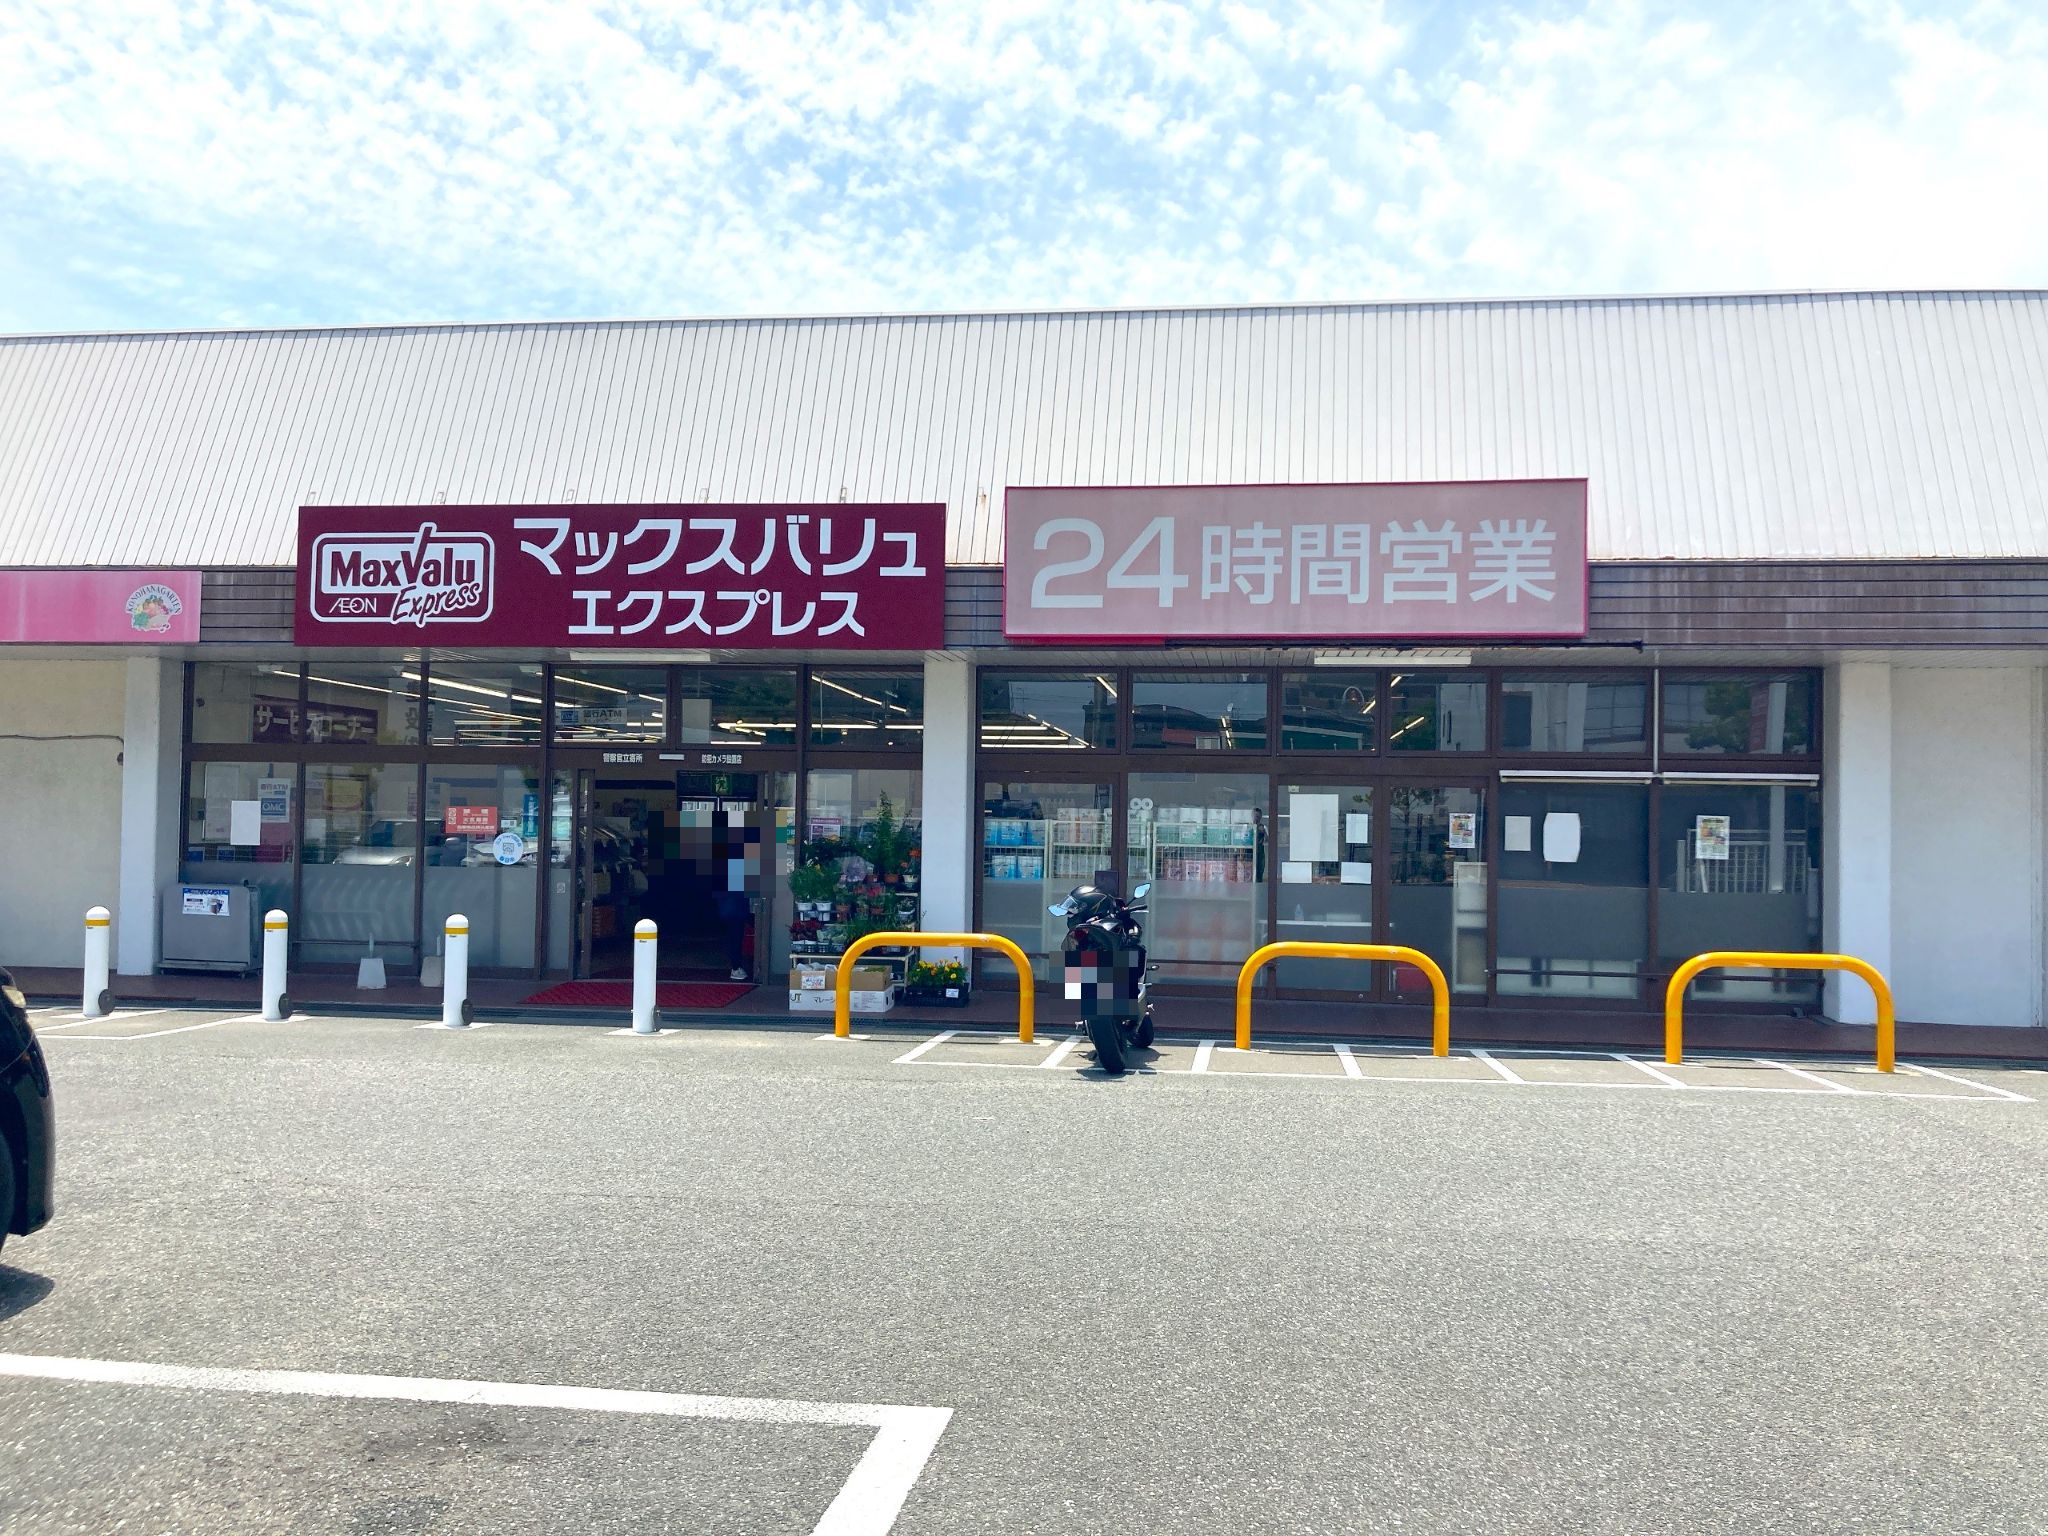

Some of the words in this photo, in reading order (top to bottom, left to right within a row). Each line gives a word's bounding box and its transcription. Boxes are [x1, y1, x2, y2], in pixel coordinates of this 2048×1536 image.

[330, 526, 476, 587] MaxValu
[513, 515, 926, 577] マックスバリュ
[1030, 516, 1557, 608] 24時間営業
[392, 572, 481, 625] Express
[568, 588, 866, 637] エクスプレス
